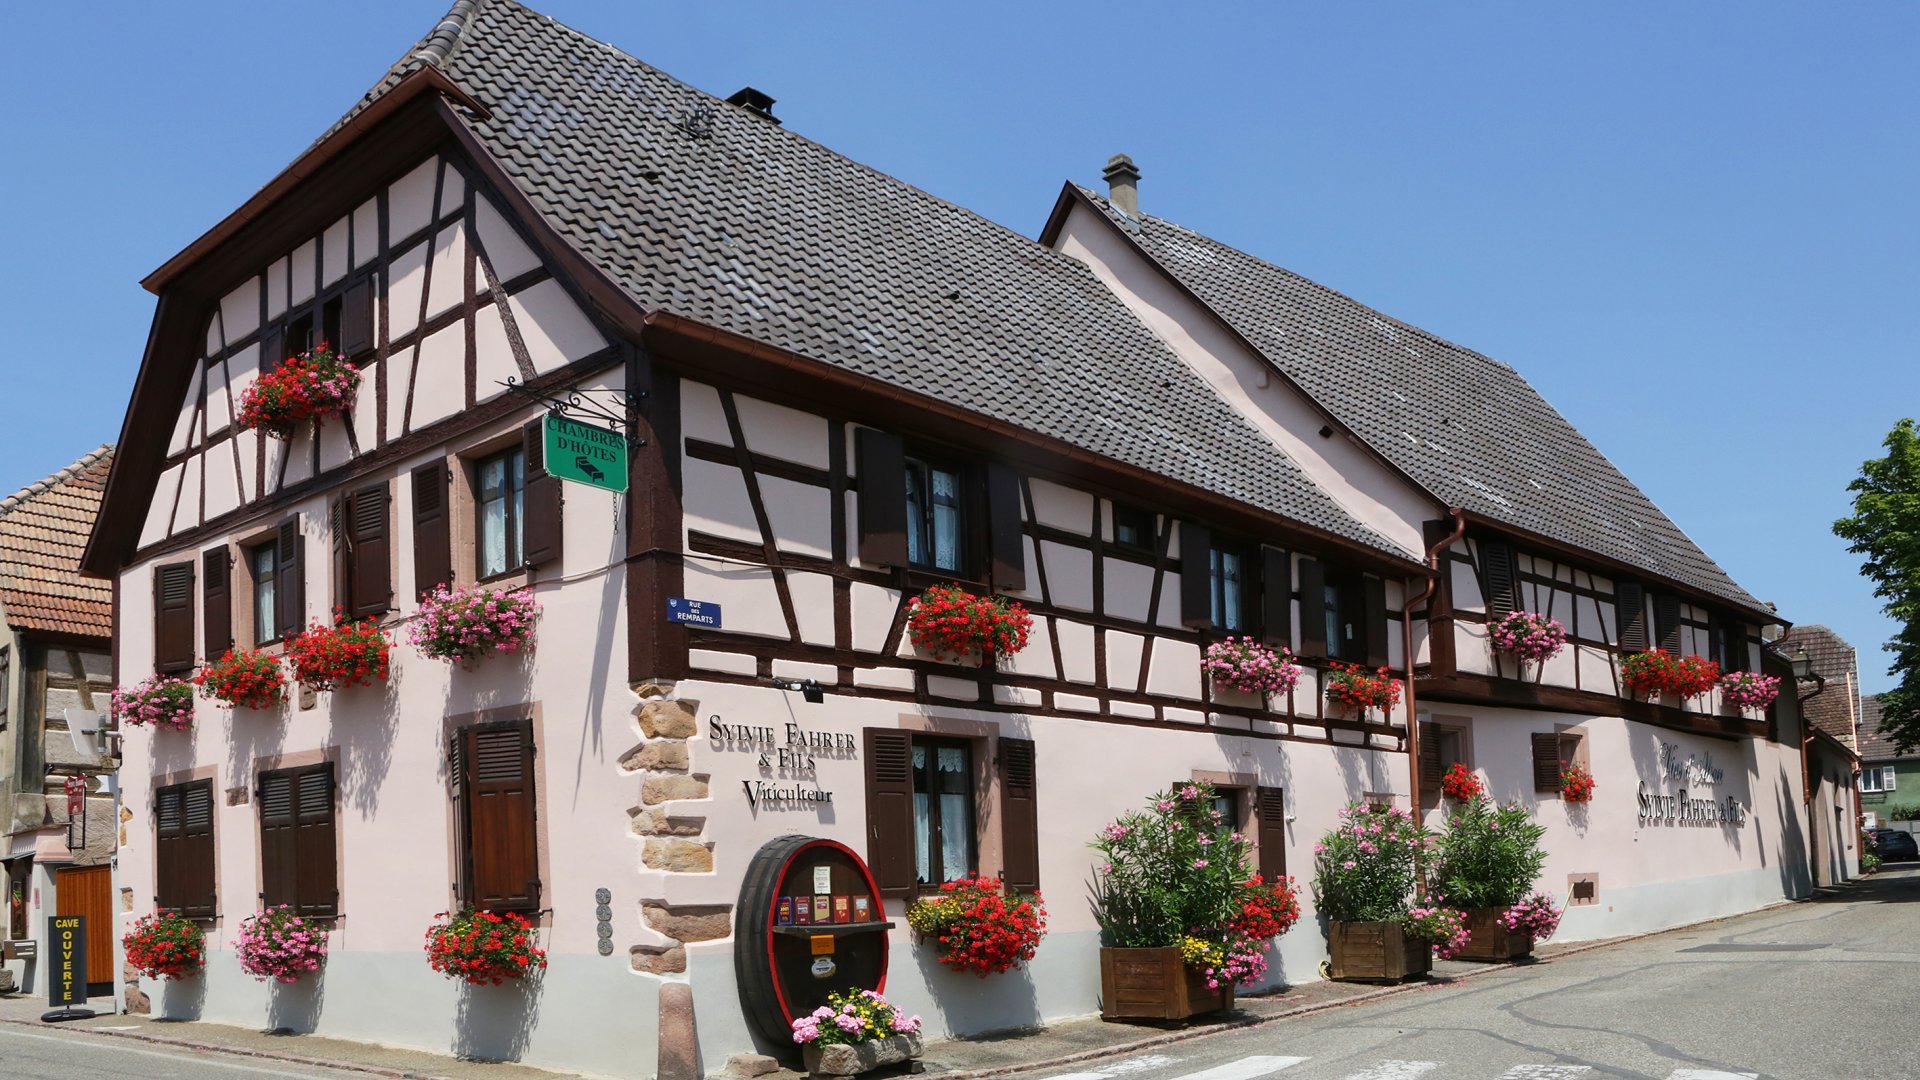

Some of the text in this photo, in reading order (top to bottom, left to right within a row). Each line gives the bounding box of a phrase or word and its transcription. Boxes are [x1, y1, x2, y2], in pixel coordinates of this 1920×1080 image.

[547, 418, 624, 449] CHAMBRES
[558, 436, 617, 463] D'HÔTES
[677, 612, 714, 624] REMPARTS
[709, 715, 856, 749] SYLVIE FAHRER
[758, 748, 816, 770] & FILS
[742, 780, 833, 810] Viticulteur
[1638, 780, 1676, 820] SYLVIE
[1678, 788, 1717, 821] FAHRER
[55, 919, 79, 928] CAVE
[62, 931, 73, 1000] OUVERTE
